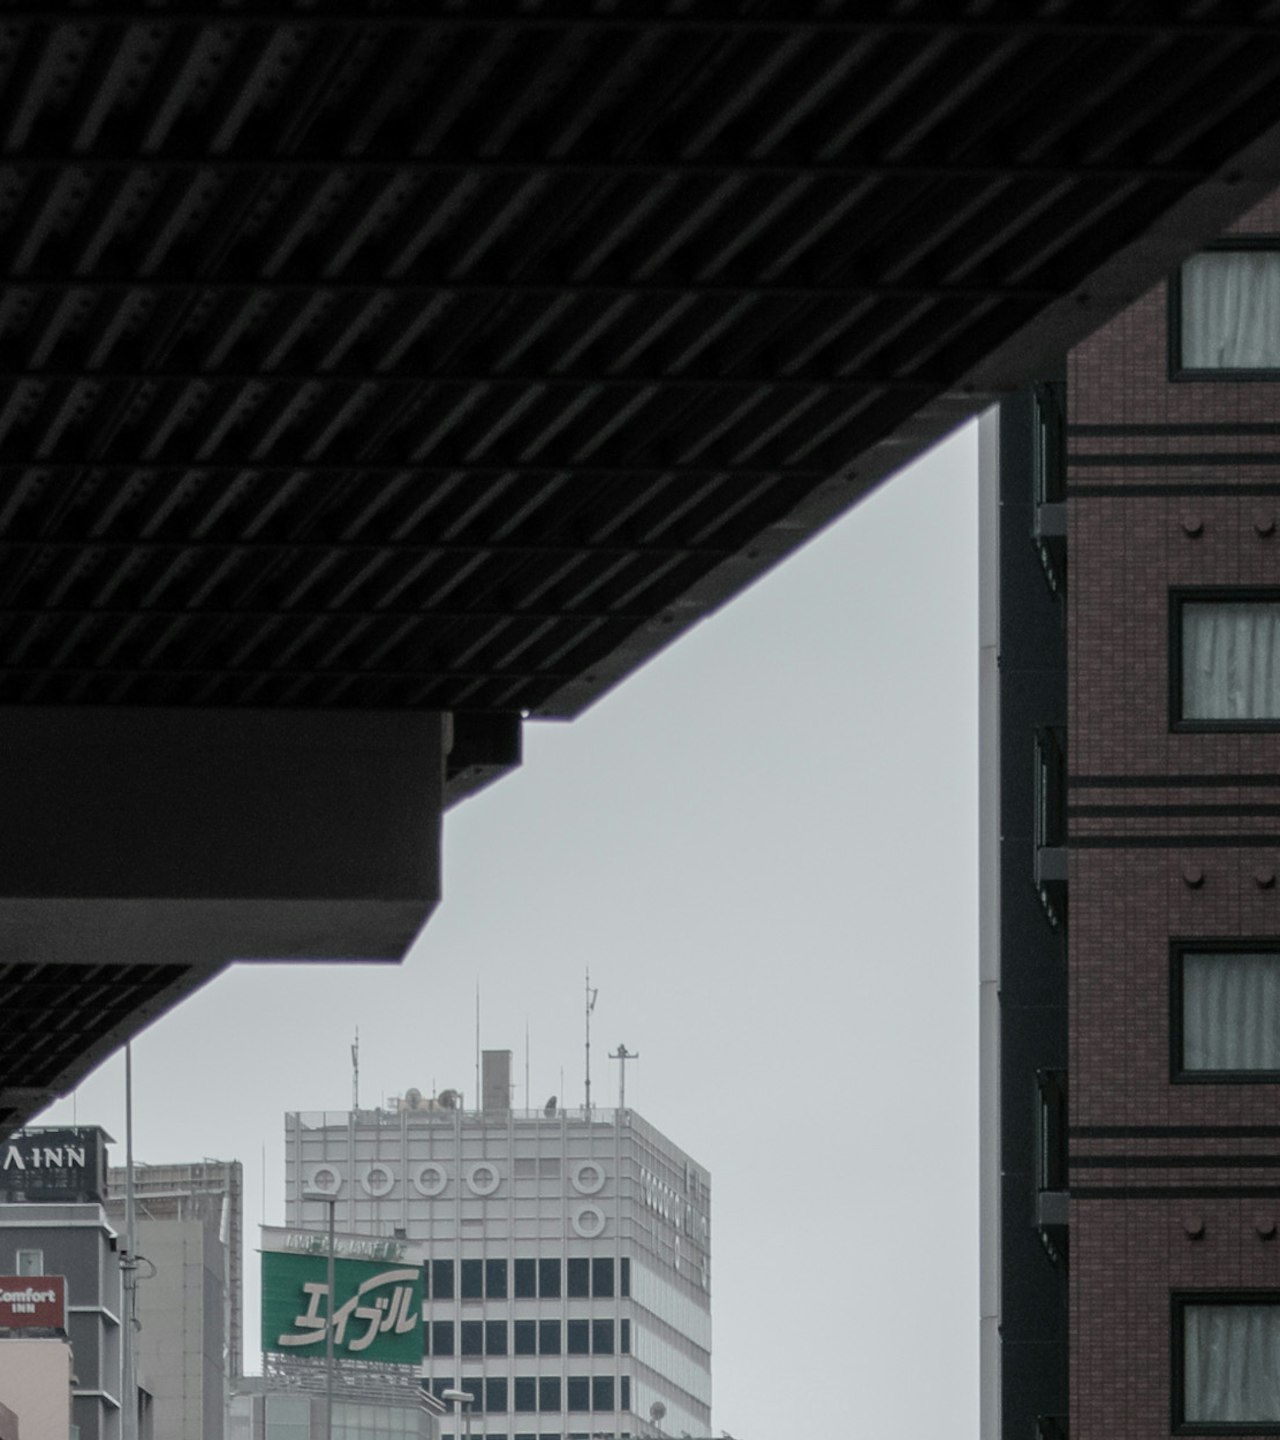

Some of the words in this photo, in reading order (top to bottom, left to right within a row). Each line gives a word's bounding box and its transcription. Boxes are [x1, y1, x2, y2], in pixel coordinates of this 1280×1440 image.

[32, 1147, 85, 1168] INN
[11, 1303, 36, 1314] INN
[278, 1269, 419, 1351] エイブル
